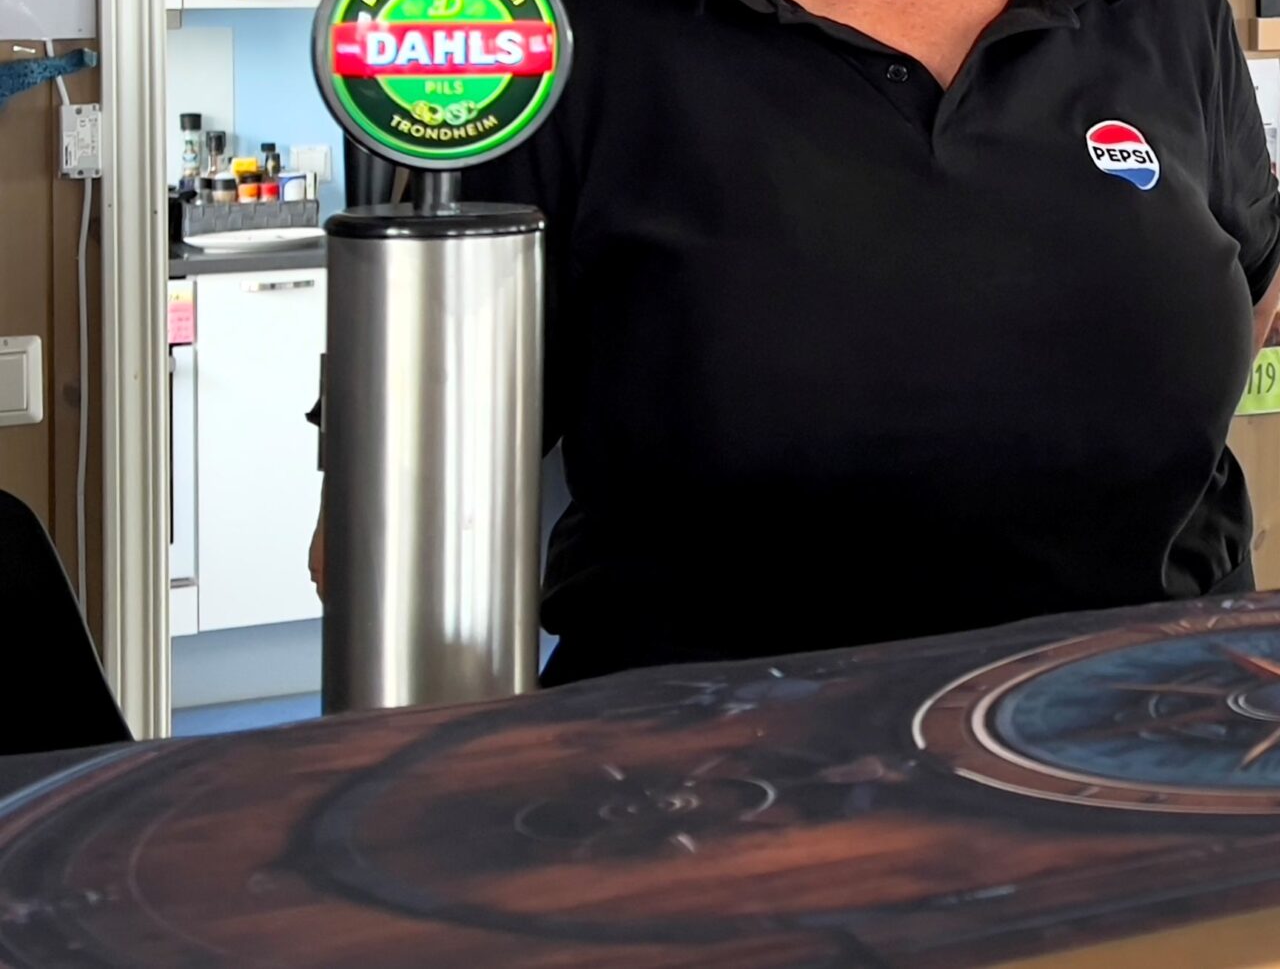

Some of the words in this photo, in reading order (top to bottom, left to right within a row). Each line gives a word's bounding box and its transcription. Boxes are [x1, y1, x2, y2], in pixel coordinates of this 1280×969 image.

[365, 30, 524, 66] DAHLS
[424, 80, 464, 95] PILS
[390, 115, 498, 140] TRONDHEIM
[1092, 146, 1154, 164] PEPSI
